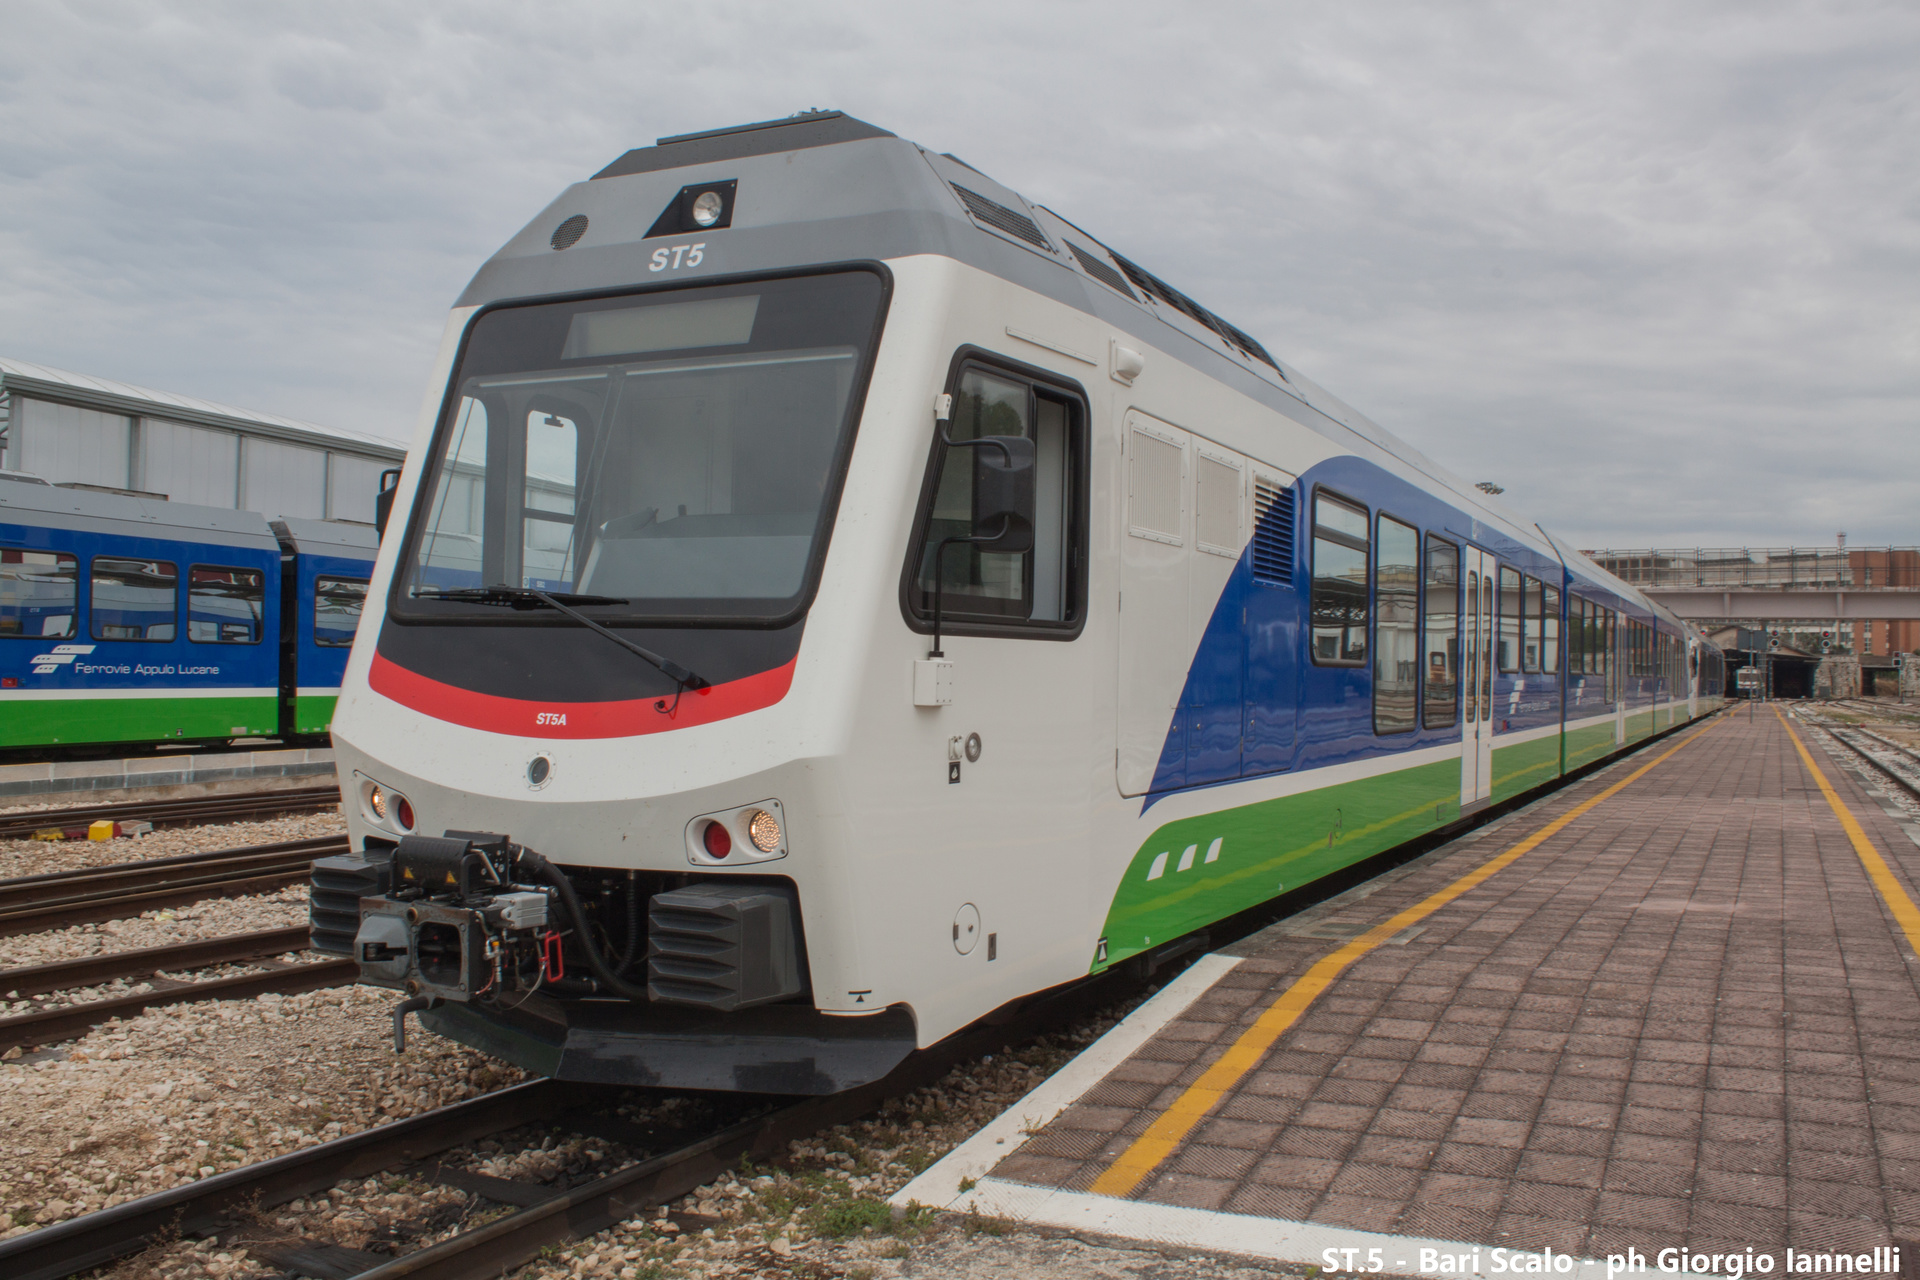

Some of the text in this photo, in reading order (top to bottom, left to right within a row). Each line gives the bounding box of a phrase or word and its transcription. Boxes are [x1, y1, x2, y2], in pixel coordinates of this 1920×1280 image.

[649, 243, 706, 272] ST5
[75, 662, 220, 676] Ferrovie Appulo Lucane
[536, 712, 567, 726] ST5A
